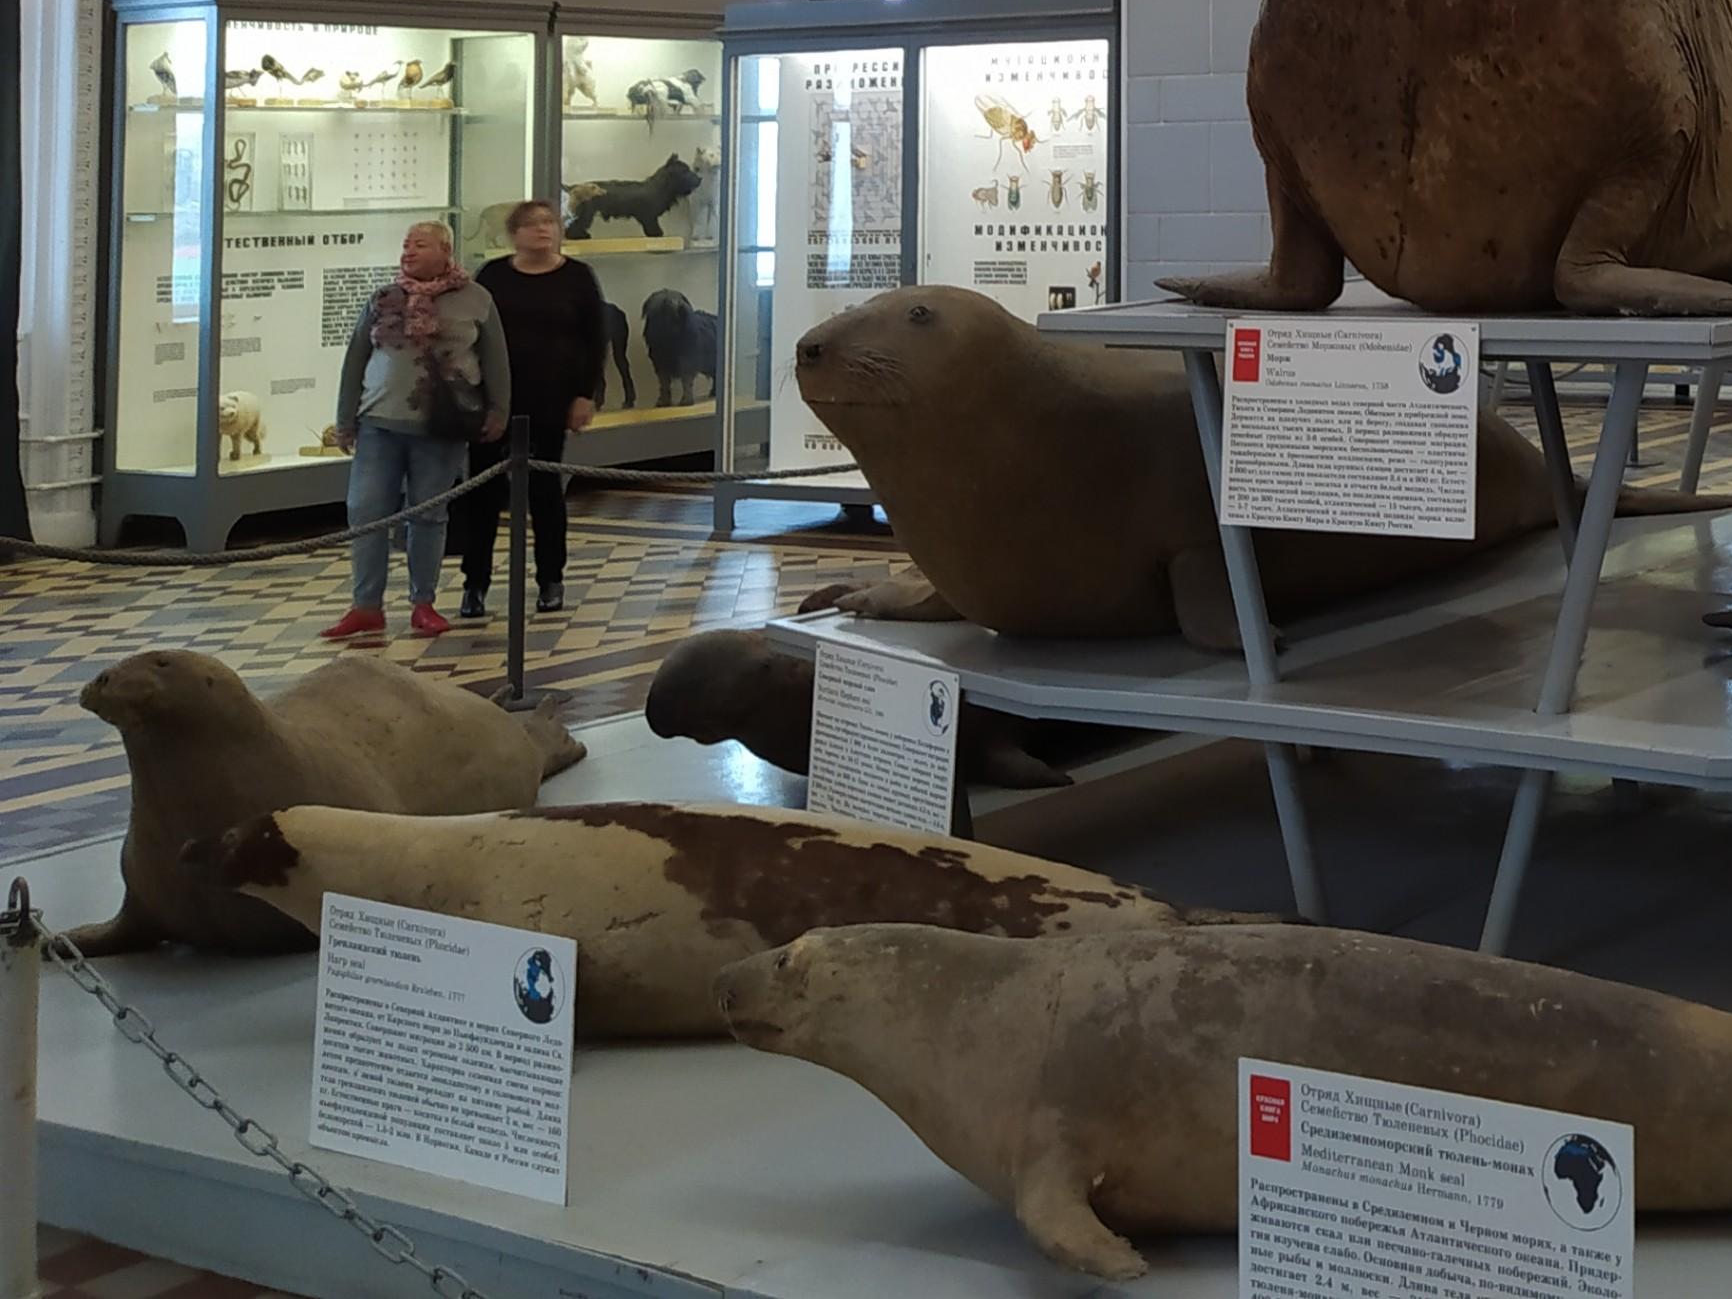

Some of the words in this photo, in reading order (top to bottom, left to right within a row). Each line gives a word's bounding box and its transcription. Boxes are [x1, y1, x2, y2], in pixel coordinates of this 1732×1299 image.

[814, 61, 899, 75] ПРРЕССИ
[322, 233, 365, 246] ОТБОР
[995, 240, 1103, 252] ИЗМЕНЧИВОС
[1267, 329, 1292, 340] Отряд
[1295, 329, 1332, 340] Хищные
[1265, 367, 1296, 378] Walrus
[1266, 353, 1291, 364] Морж
[329, 905, 355, 921] Отряд
[358, 910, 395, 928] Хищные
[327, 951, 348, 968] Harp
[350, 959, 366, 971] seal
[1300, 1083, 1340, 1103] Отряд
[1345, 1089, 1403, 1113] Хищные
[1404, 1100, 1482, 1128] (Carnivora)
[1300, 1100, 1369, 1124] Семейство
[1374, 1111, 1449, 1140] Тюленевых
[1454, 1127, 1525, 1154] (Phocidae)
[1300, 1121, 1433, 1157] Средиземноморский
[1438, 1148, 1535, 1177] тюлень-монах
[1301, 1142, 1394, 1173] Mediterranean
[1399, 1161, 1435, 1181] Monk
[1440, 1171, 1466, 1187] seal
[1302, 1160, 1356, 1181] Monachus
[1359, 1173, 1413, 1192] monachus
[1476, 1194, 1505, 1210] 1779
[1250, 1177, 1350, 1209] Распространены
[1352, 1201, 1359, 1211] в
[1362, 1200, 1445, 1229] Средиземном
[1448, 1219, 1456, 1230] и
[1459, 1218, 1509, 1240] Черном
[1512, 1232, 1557, 1252] морях,
[1560, 1242, 1567, 1254] а
[1570, 1244, 1612, 1263] также
[1615, 1253, 1622, 1267] у
[1250, 1195, 1338, 1223] Африканского
[1340, 1214, 1406, 1238] побережья
[1410, 1226, 1512, 1259] Атлантического
[1515, 1251, 1564, 1271] океана.
[1568, 1259, 1622, 1284] Придер-
[1250, 1211, 1310, 1234] живаются
[1314, 1226, 1343, 1241] скал
[1348, 1233, 1372, 1247] или
[1376, 1237, 1492, 1273] песчано-галечных
[1497, 1265, 1572, 1290] побережий.
[1578, 1279, 1622, 1299] Эколо-
[1250, 1228, 1271, 1242] гия
[1273, 1232, 1321, 1254] изучена
[1322, 1244, 1361, 1261] слабо.
[1363, 1250, 1423, 1274] Основная
[1425, 1267, 1476, 1287] добыча,
[1250, 1246, 1274, 1258] ные
[1278, 1251, 1311, 1267] рыбы
[1316, 1260, 1323, 1270] и
[1328, 1261, 1394, 1285] моллюски.
[1398, 1275, 1438, 1295] Длина
[1250, 1262, 1307, 1283] достигает
[1361, 1286, 1380, 1298] вес
